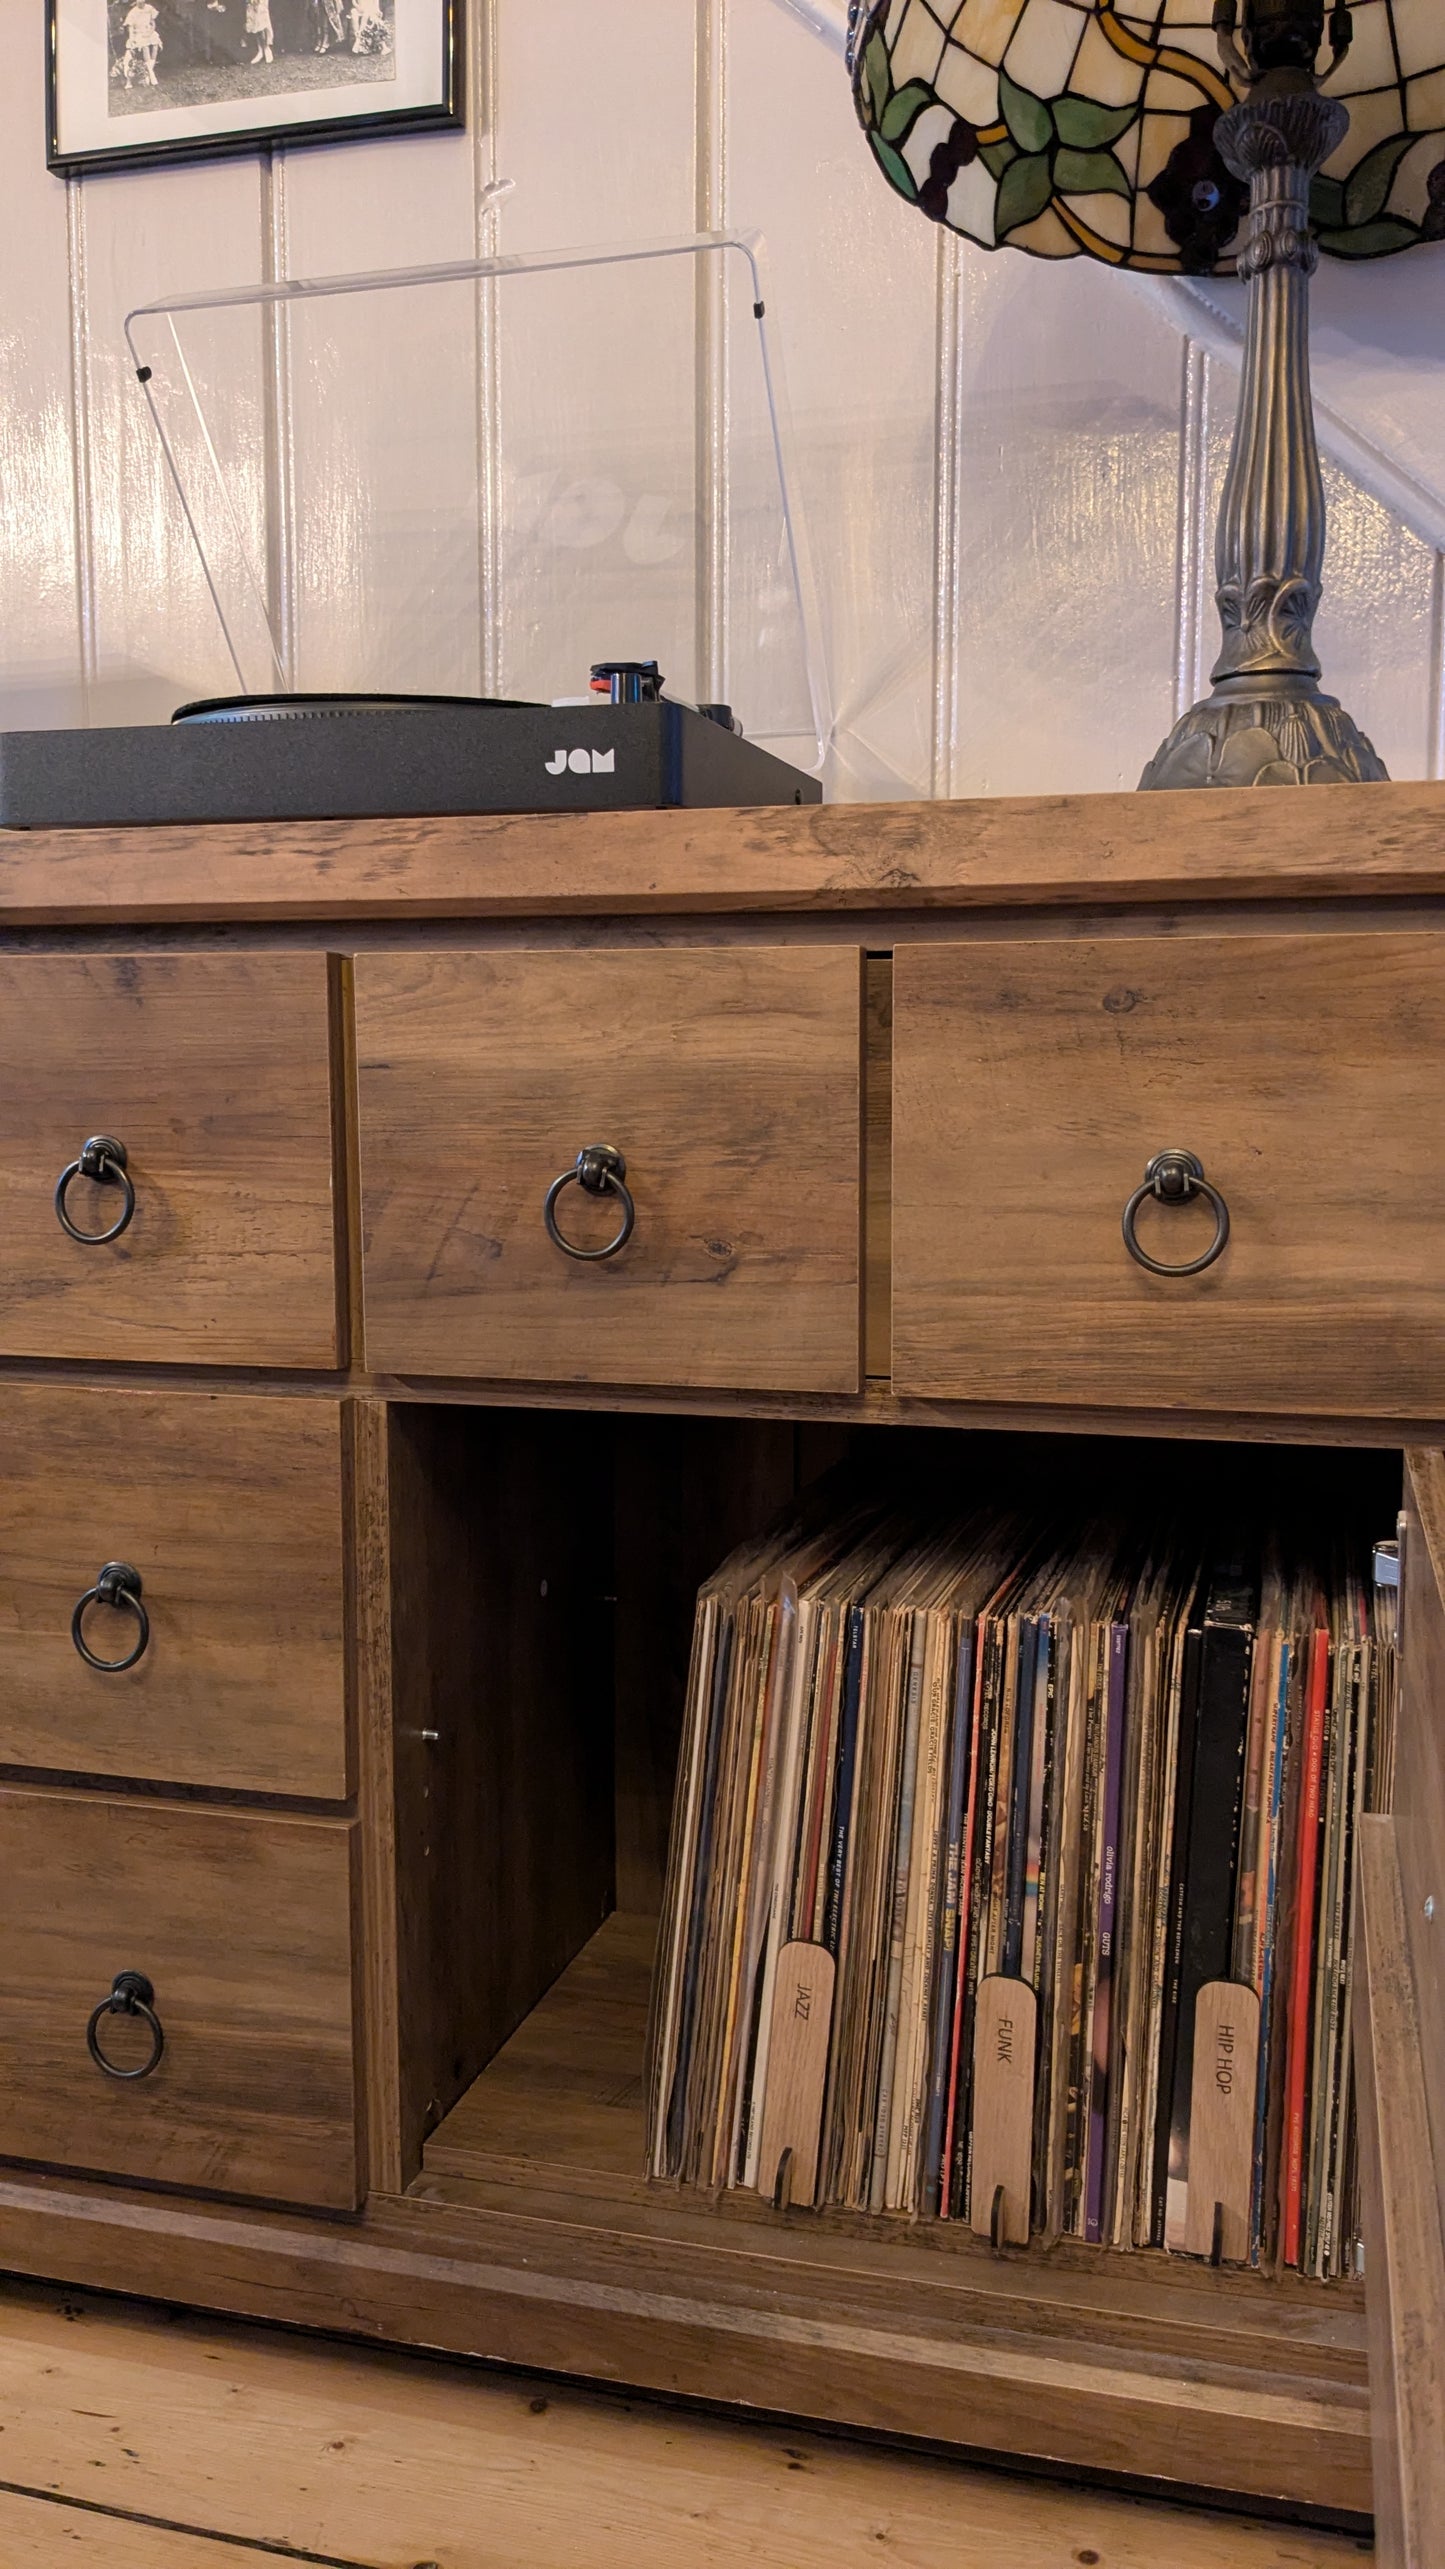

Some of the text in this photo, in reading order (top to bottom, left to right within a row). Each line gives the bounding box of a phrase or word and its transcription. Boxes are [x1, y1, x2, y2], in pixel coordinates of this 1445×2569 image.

[545, 748, 614, 775] JAM
[911, 1671, 919, 1704] GENESIS
[1312, 1710, 1320, 1734] STATUS
[1267, 1751, 1275, 1786] BREAKFAST
[1310, 1774, 1316, 1783] OF
[984, 1809, 992, 1835] DOUBLE
[1265, 1796, 1273, 1824] AMERICA
[983, 1836, 991, 1865] FANTASY
[832, 1888, 840, 1903] THE
[834, 1878, 841, 1888] OF
[943, 1841, 958, 1952] THE JAM SNAP!
[1102, 1846, 1114, 1956] olivia rodrigo GUTS
[829, 1904, 838, 1939] ELECTRIC
[990, 1913, 998, 1933] AFTER
[989, 1935, 997, 1955] NIGHT
[1174, 1932, 1182, 1964] BOTTLEMEN
[794, 1983, 812, 2021] JAZZ
[997, 2018, 1014, 2064] FUNK
[1216, 2025, 1235, 2095] HIP HOP
